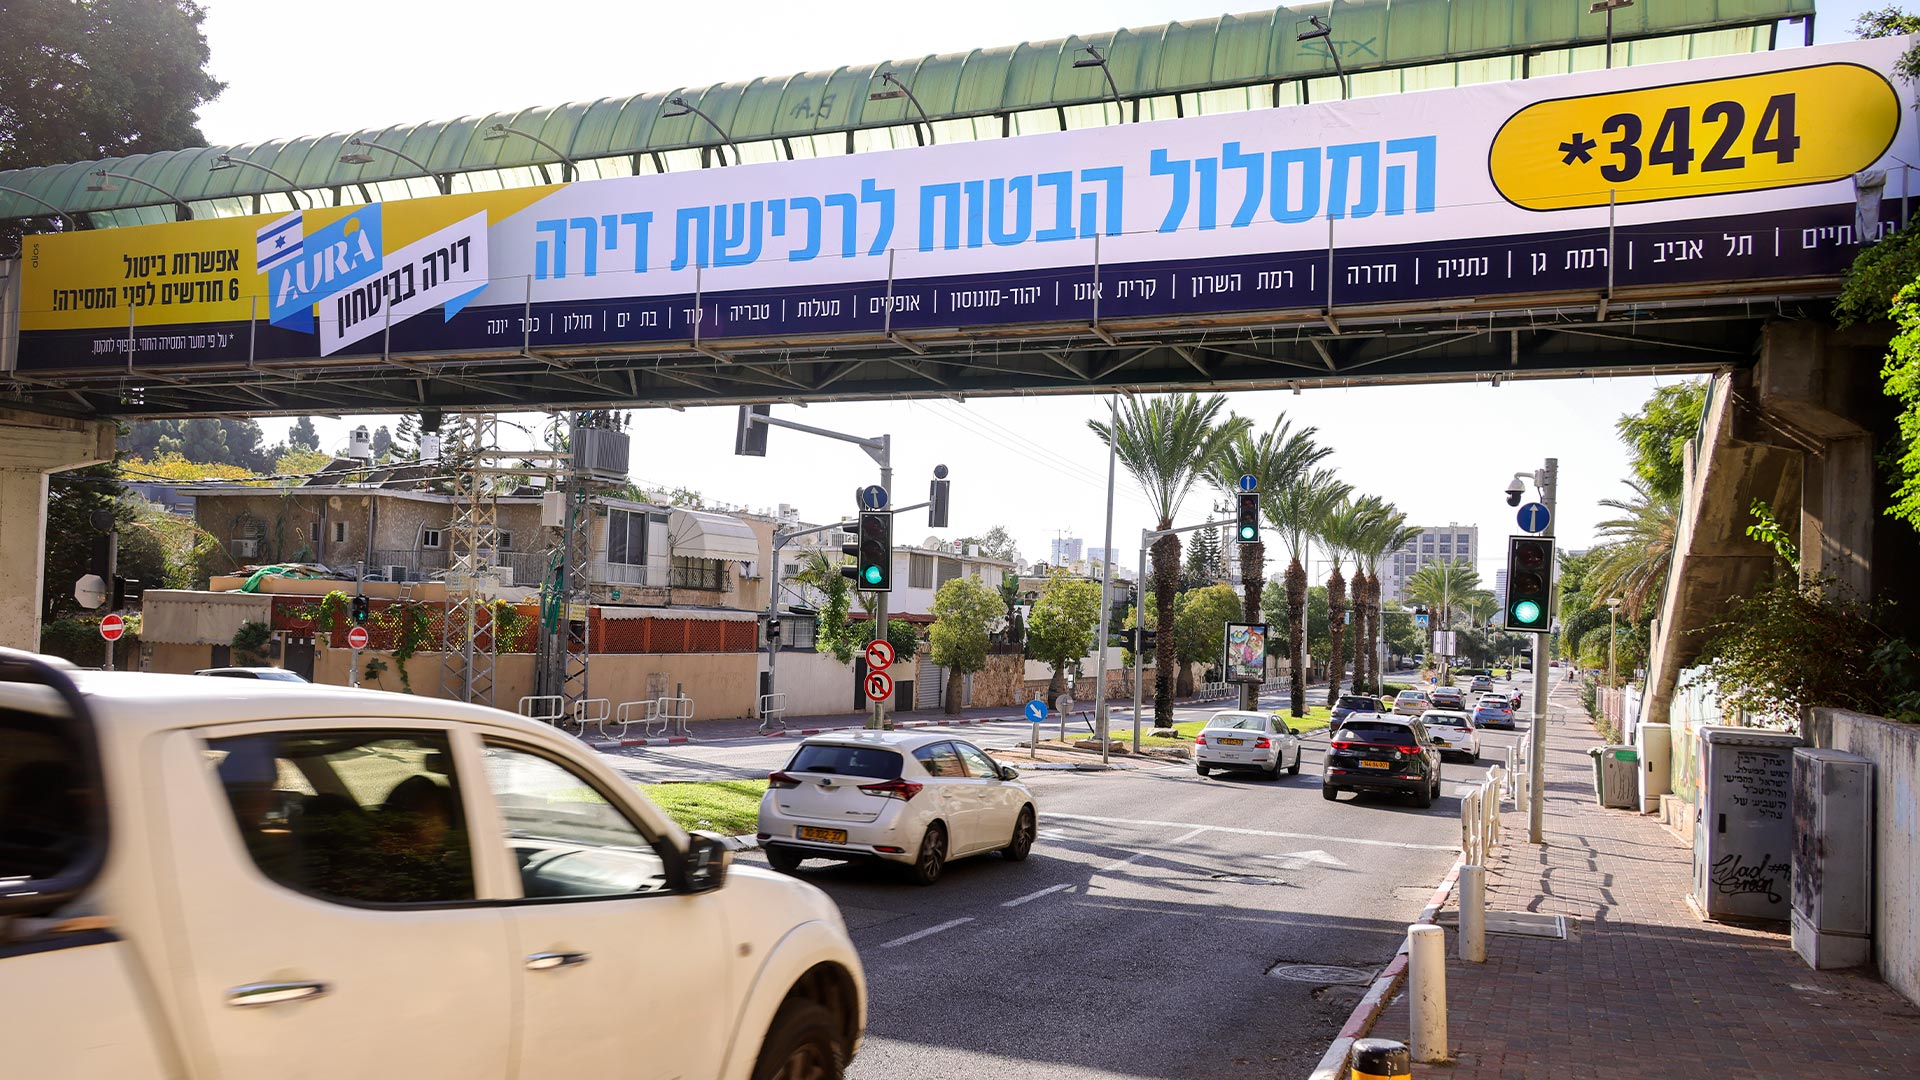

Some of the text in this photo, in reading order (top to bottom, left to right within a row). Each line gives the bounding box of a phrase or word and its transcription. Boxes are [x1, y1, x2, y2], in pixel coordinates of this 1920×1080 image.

[535, 136, 1437, 280] המסלול הבטוח לרכישת דירה
[1653, 239, 1703, 263] אביב
[1724, 233, 1752, 256] תל
[124, 249, 239, 278] אפשרות ביטול
[276, 229, 375, 308] AURA
[1438, 257, 1488, 279] נתניה
[1531, 253, 1547, 275] גן
[1565, 248, 1608, 269] רמת
[1192, 271, 1241, 297] השרון
[1256, 270, 1293, 290] רמת
[1348, 264, 1397, 285] חדרה
[53, 278, 239, 311] 6 חודשים לפני המסירה!
[338, 236, 470, 338] דירה בביטחון
[1073, 282, 1103, 301] אונו
[1117, 279, 1156, 300] קרית
[797, 298, 840, 318] מעלות
[951, 286, 1041, 312] יהוד-מונוסון
[563, 312, 592, 333] חולון
[617, 312, 630, 328] ים
[640, 311, 657, 327] בת
[730, 304, 770, 322] טבריה
[487, 319, 508, 334] יונה
[159, 336, 186, 350] המסירה
[188, 335, 206, 348] מועד
[208, 334, 216, 348] פי
[217, 332, 227, 347] על
[1736, 766, 1790, 778] ראש ממשלת
[1762, 757, 1785, 768] יצחק
[1723, 774, 1787, 788] ישראל החמישי
[1733, 794, 1787, 809] השביעי של
[1759, 808, 1783, 820] צה"ל
